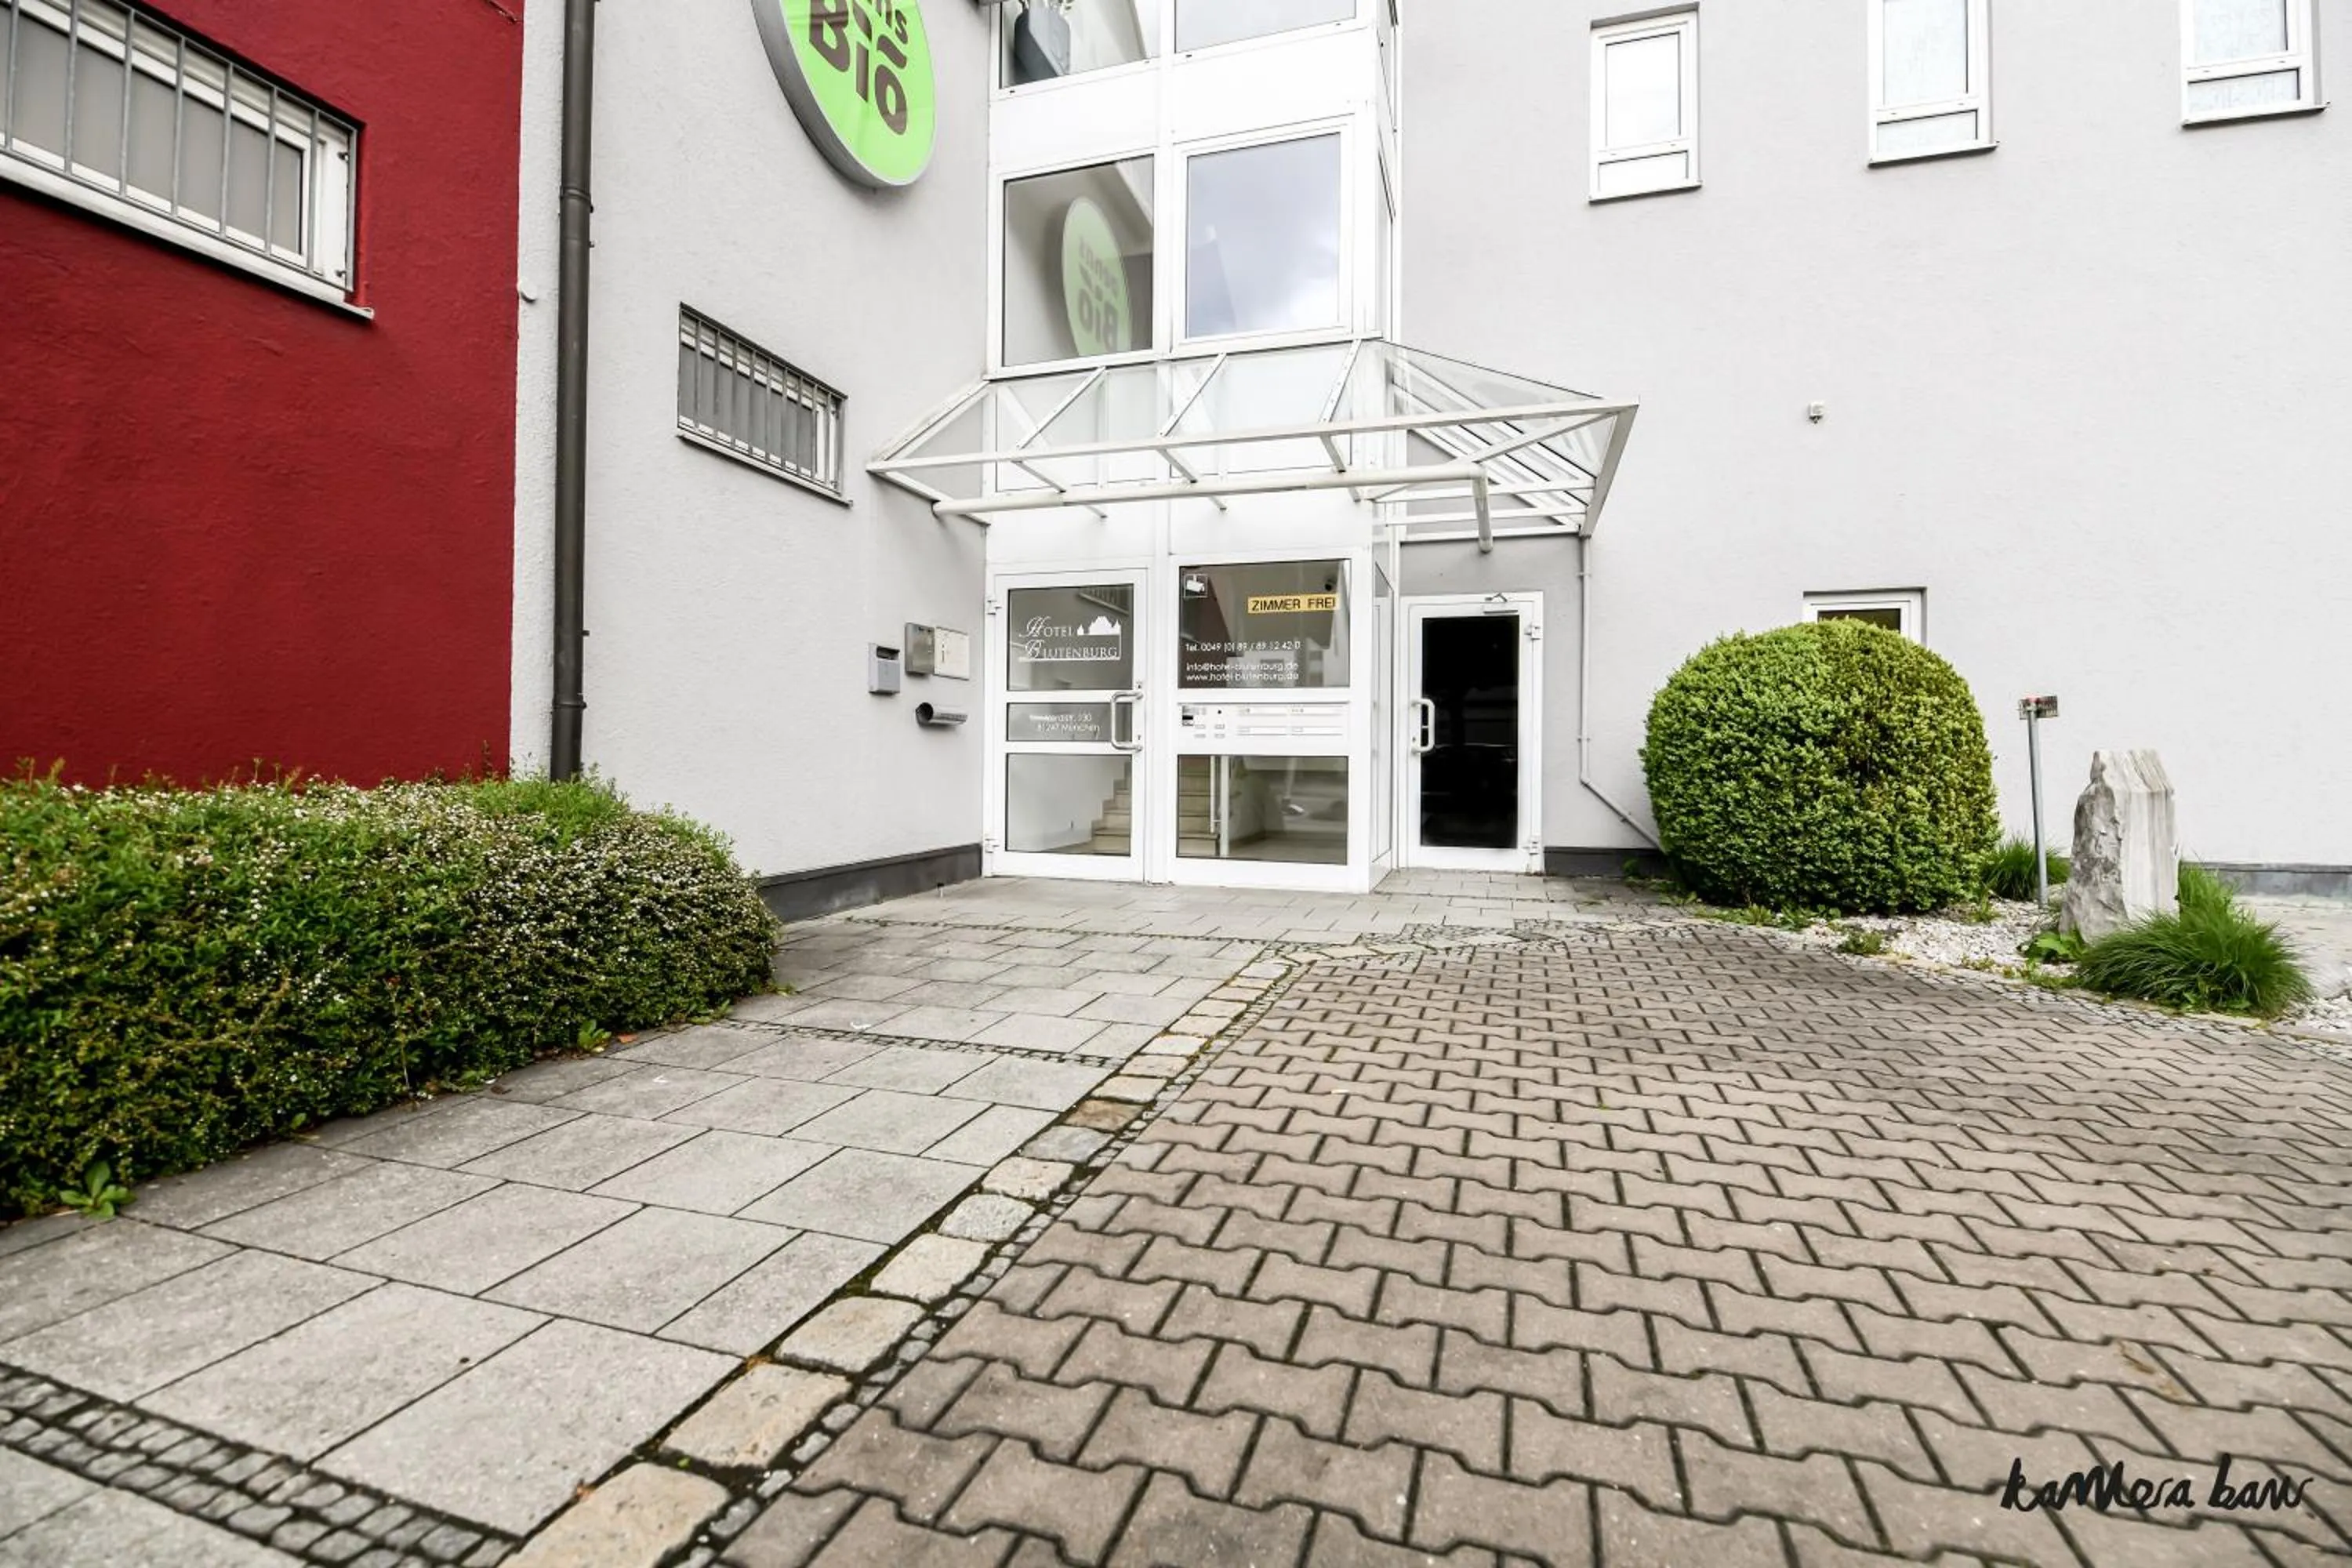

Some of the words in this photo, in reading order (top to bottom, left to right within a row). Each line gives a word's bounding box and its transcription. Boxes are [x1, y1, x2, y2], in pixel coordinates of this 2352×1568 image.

[1251, 599, 1301, 612] ZIMMER
[1307, 597, 1336, 609] FREI
[1200, 642, 1221, 652] 0049
[1282, 641, 1293, 650] 42
[1294, 640, 1301, 650] 0
